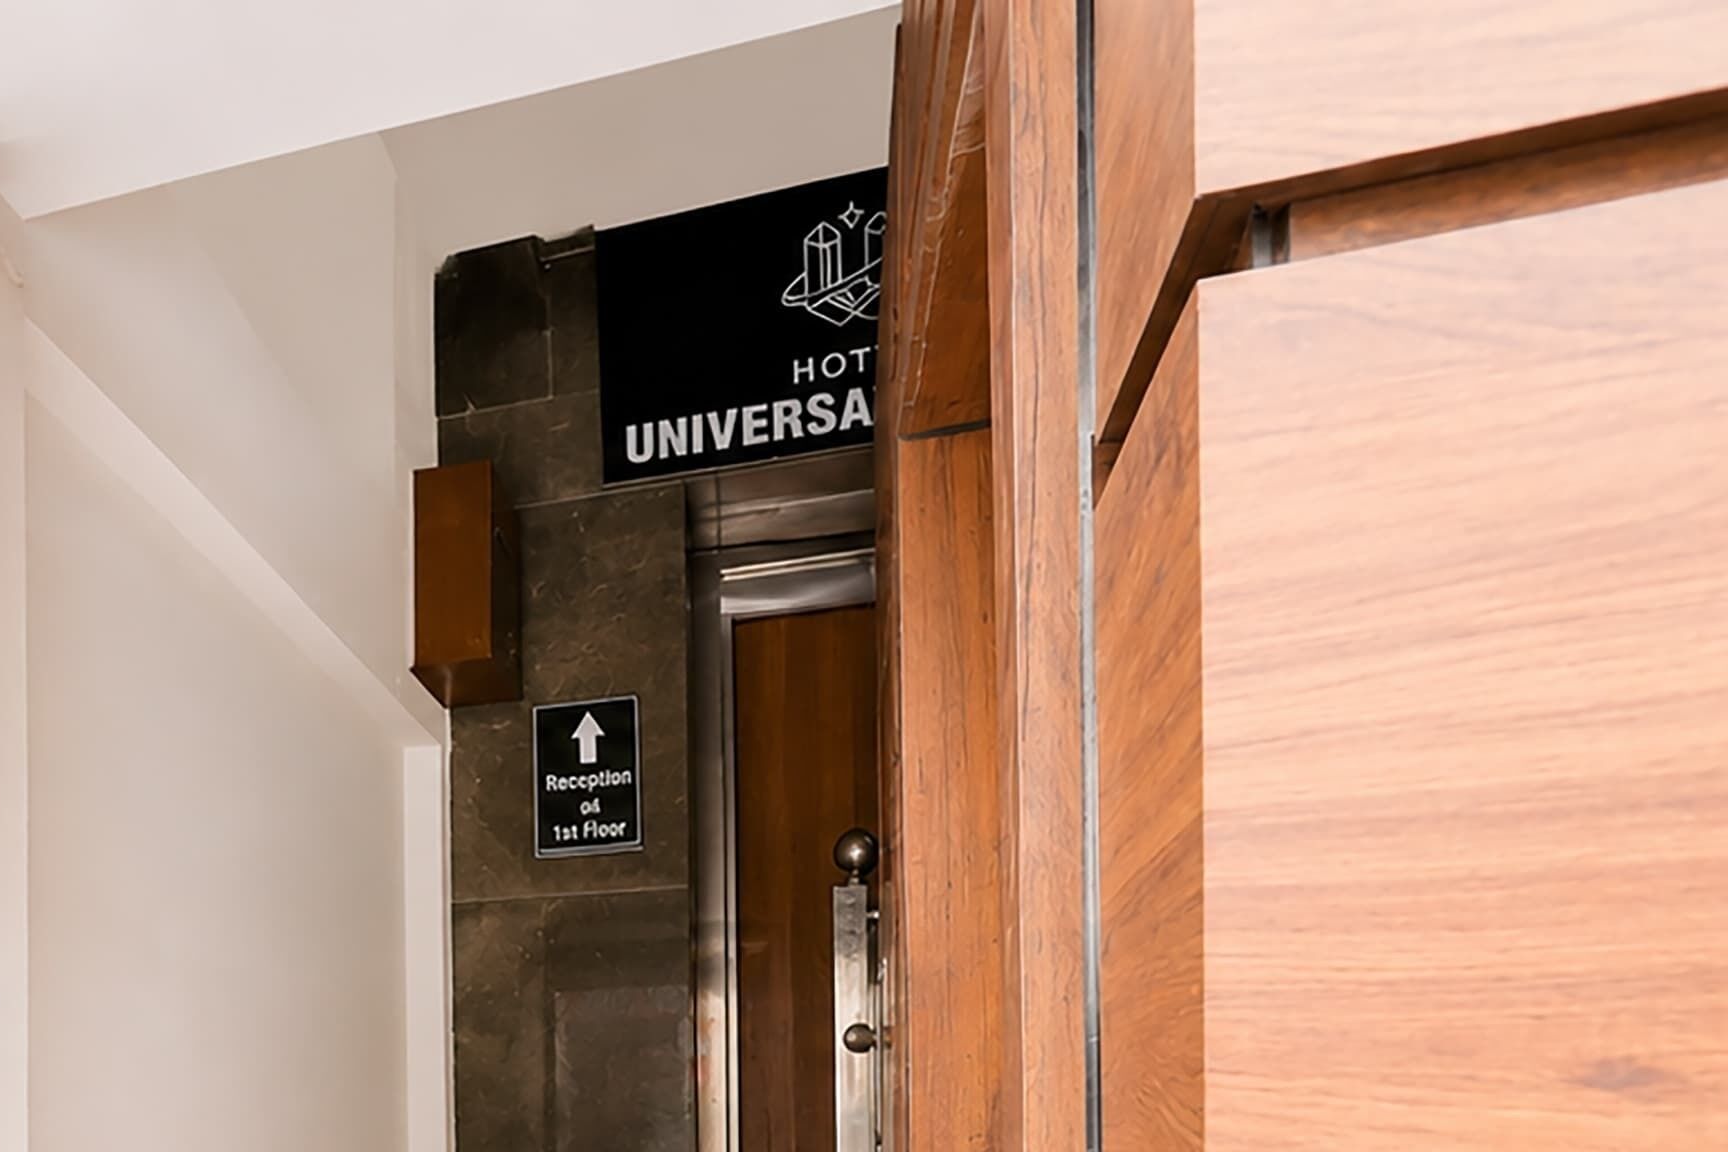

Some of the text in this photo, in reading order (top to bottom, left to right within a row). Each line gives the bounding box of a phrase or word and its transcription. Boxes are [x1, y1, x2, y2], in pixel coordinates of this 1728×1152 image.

[793, 345, 878, 384] HOT
[626, 386, 876, 464] UNIVERSA
[545, 769, 632, 793] Reception
[553, 819, 627, 841] 1st Floor
